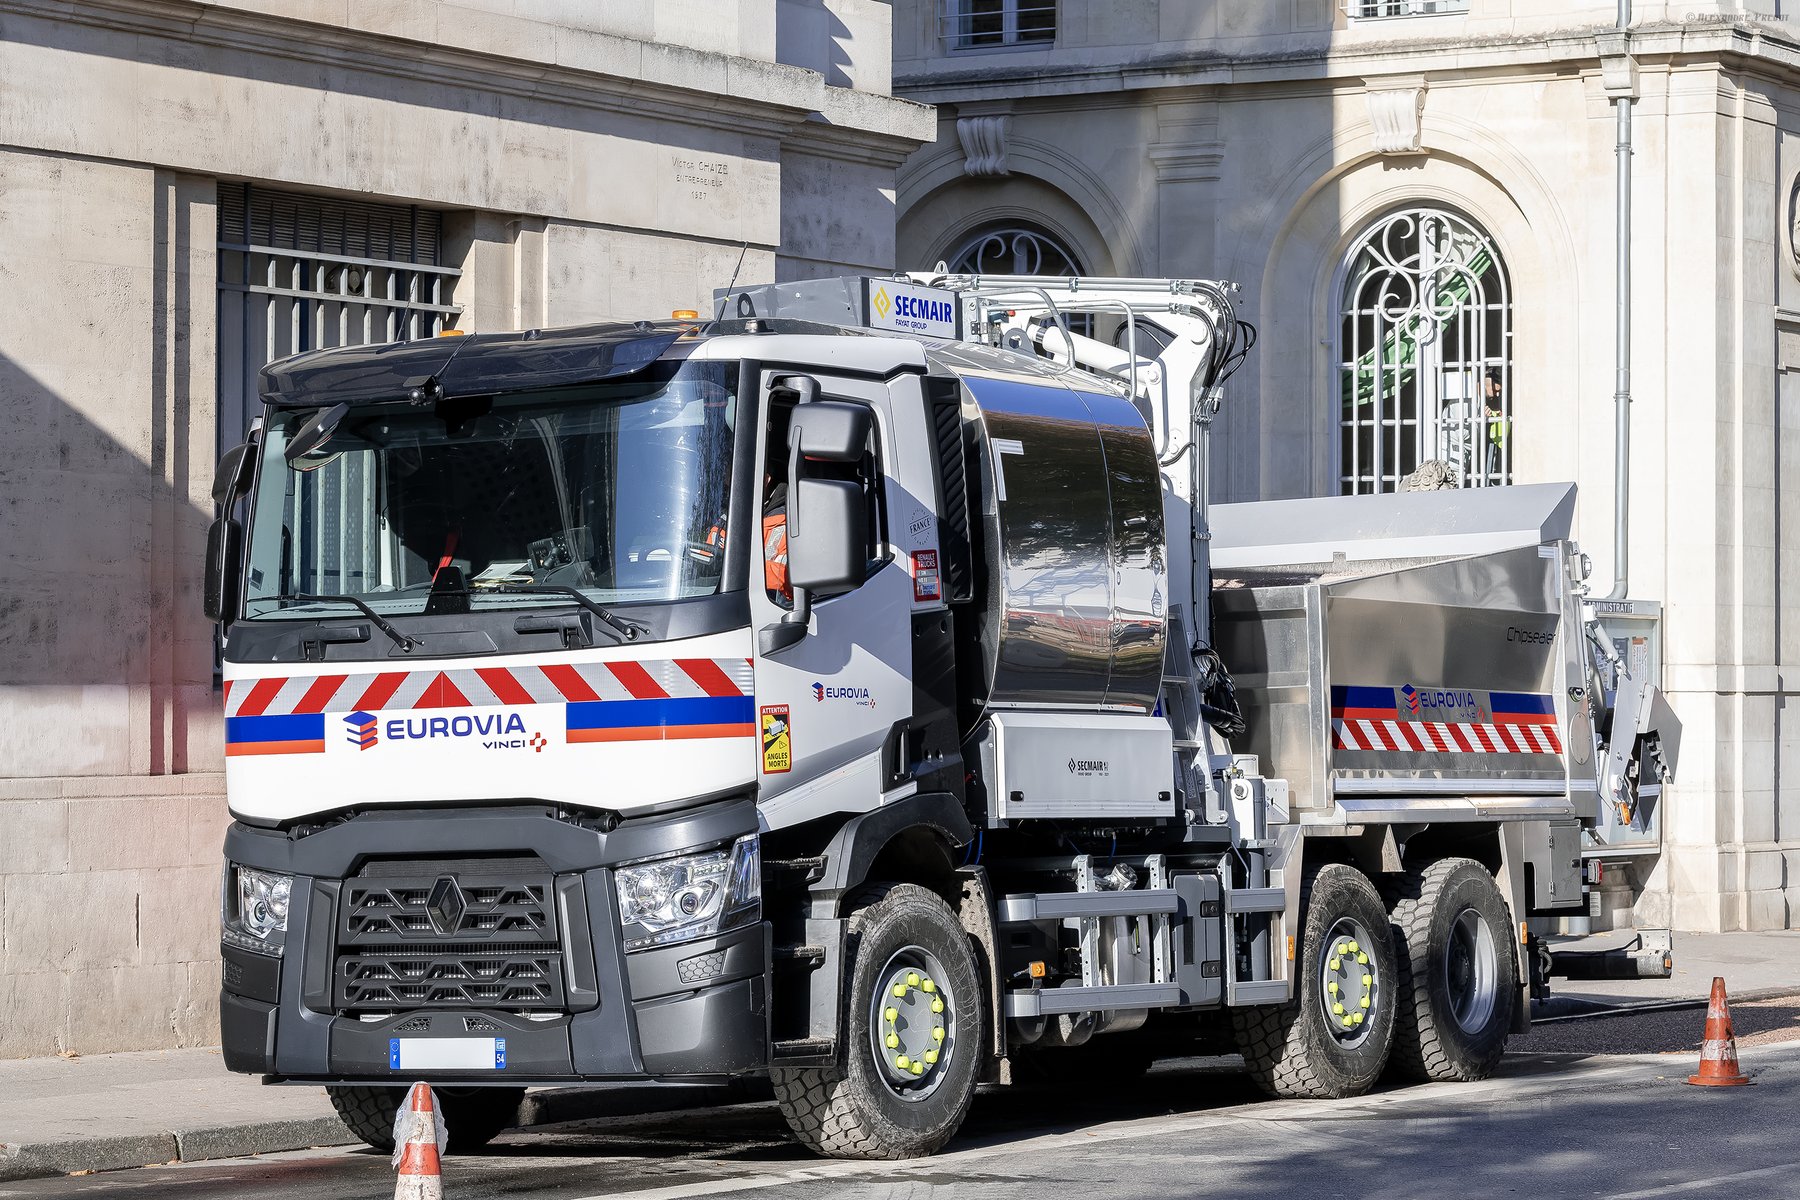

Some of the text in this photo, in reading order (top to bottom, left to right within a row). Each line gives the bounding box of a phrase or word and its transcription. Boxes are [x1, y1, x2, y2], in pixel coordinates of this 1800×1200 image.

[895, 295, 953, 323] SECMAIR
[896, 318, 928, 330] FAYAT GROUP
[910, 517, 930, 534] FRANCE
[917, 553, 935, 561] RENAULT
[918, 560, 936, 568] TRUCKS
[826, 687, 870, 699] EUROVIA
[1420, 691, 1476, 708] EUROVIA
[762, 706, 788, 714] ATTENTION
[386, 713, 526, 740] EUROVIA
[483, 739, 526, 749] VINCI
[767, 752, 788, 760] ANGLES
[768, 760, 787, 768] MORTS
[1077, 760, 1103, 771] SECMAIR
[496, 1053, 505, 1064] 54
